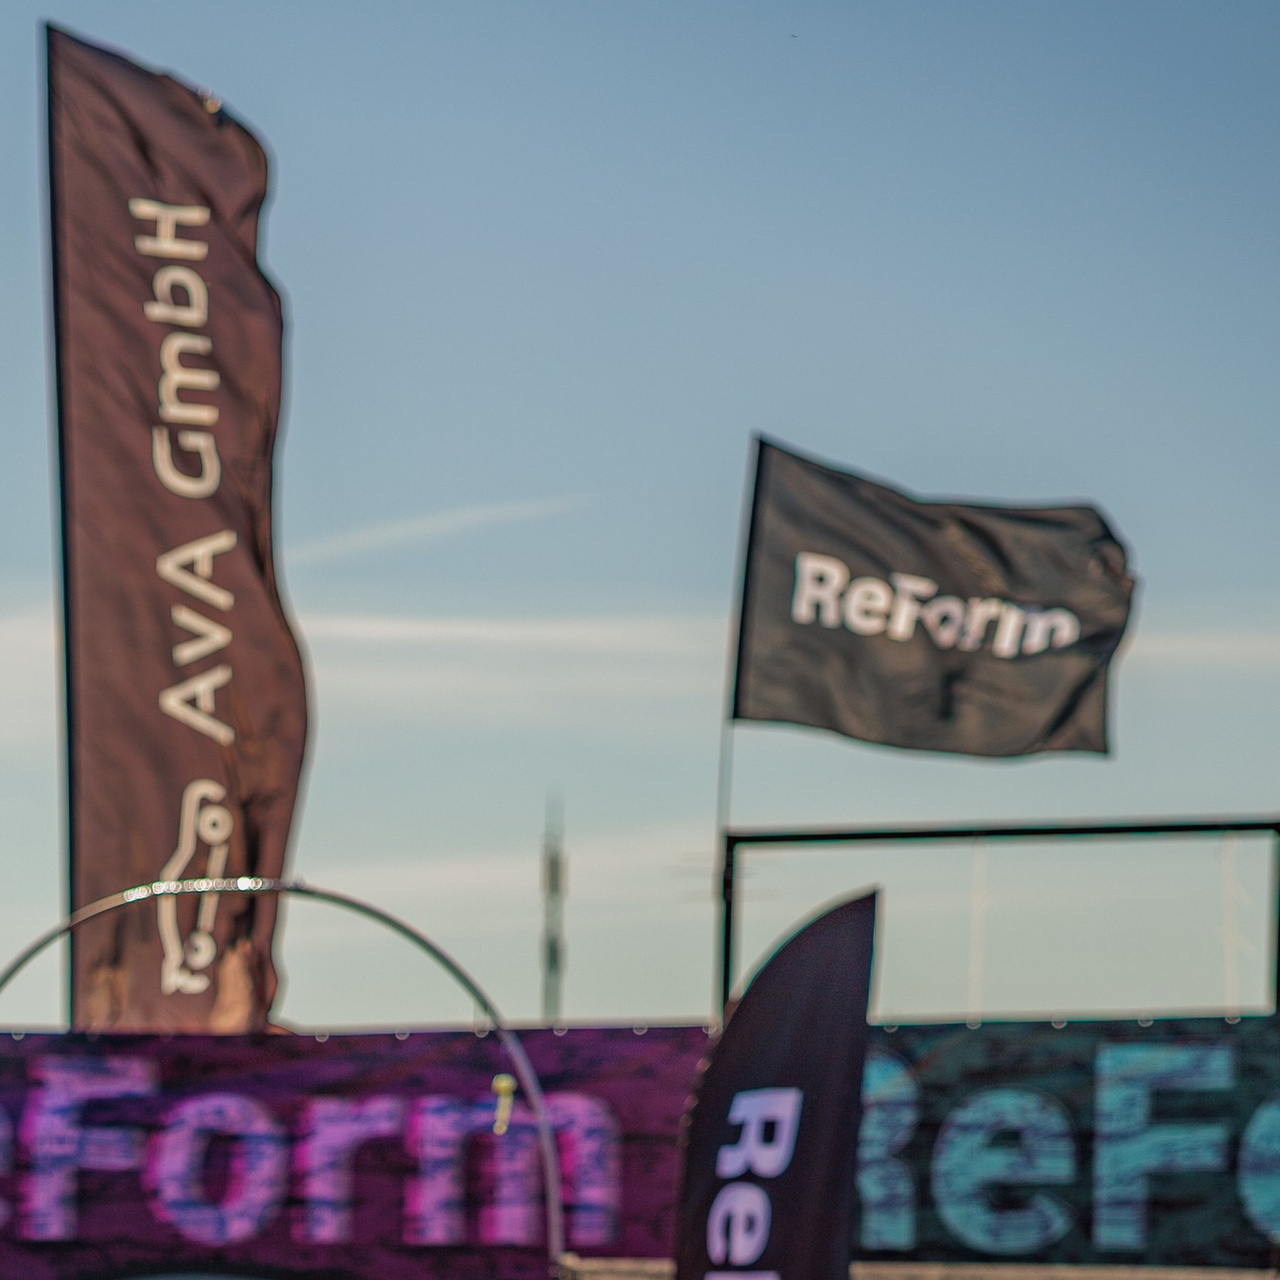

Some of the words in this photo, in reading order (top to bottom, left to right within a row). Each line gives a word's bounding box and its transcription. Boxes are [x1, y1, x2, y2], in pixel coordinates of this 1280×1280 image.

[128, 197, 222, 499] GmbH
[159, 529, 238, 747] AvA
[791, 551, 1081, 660] ReForm
